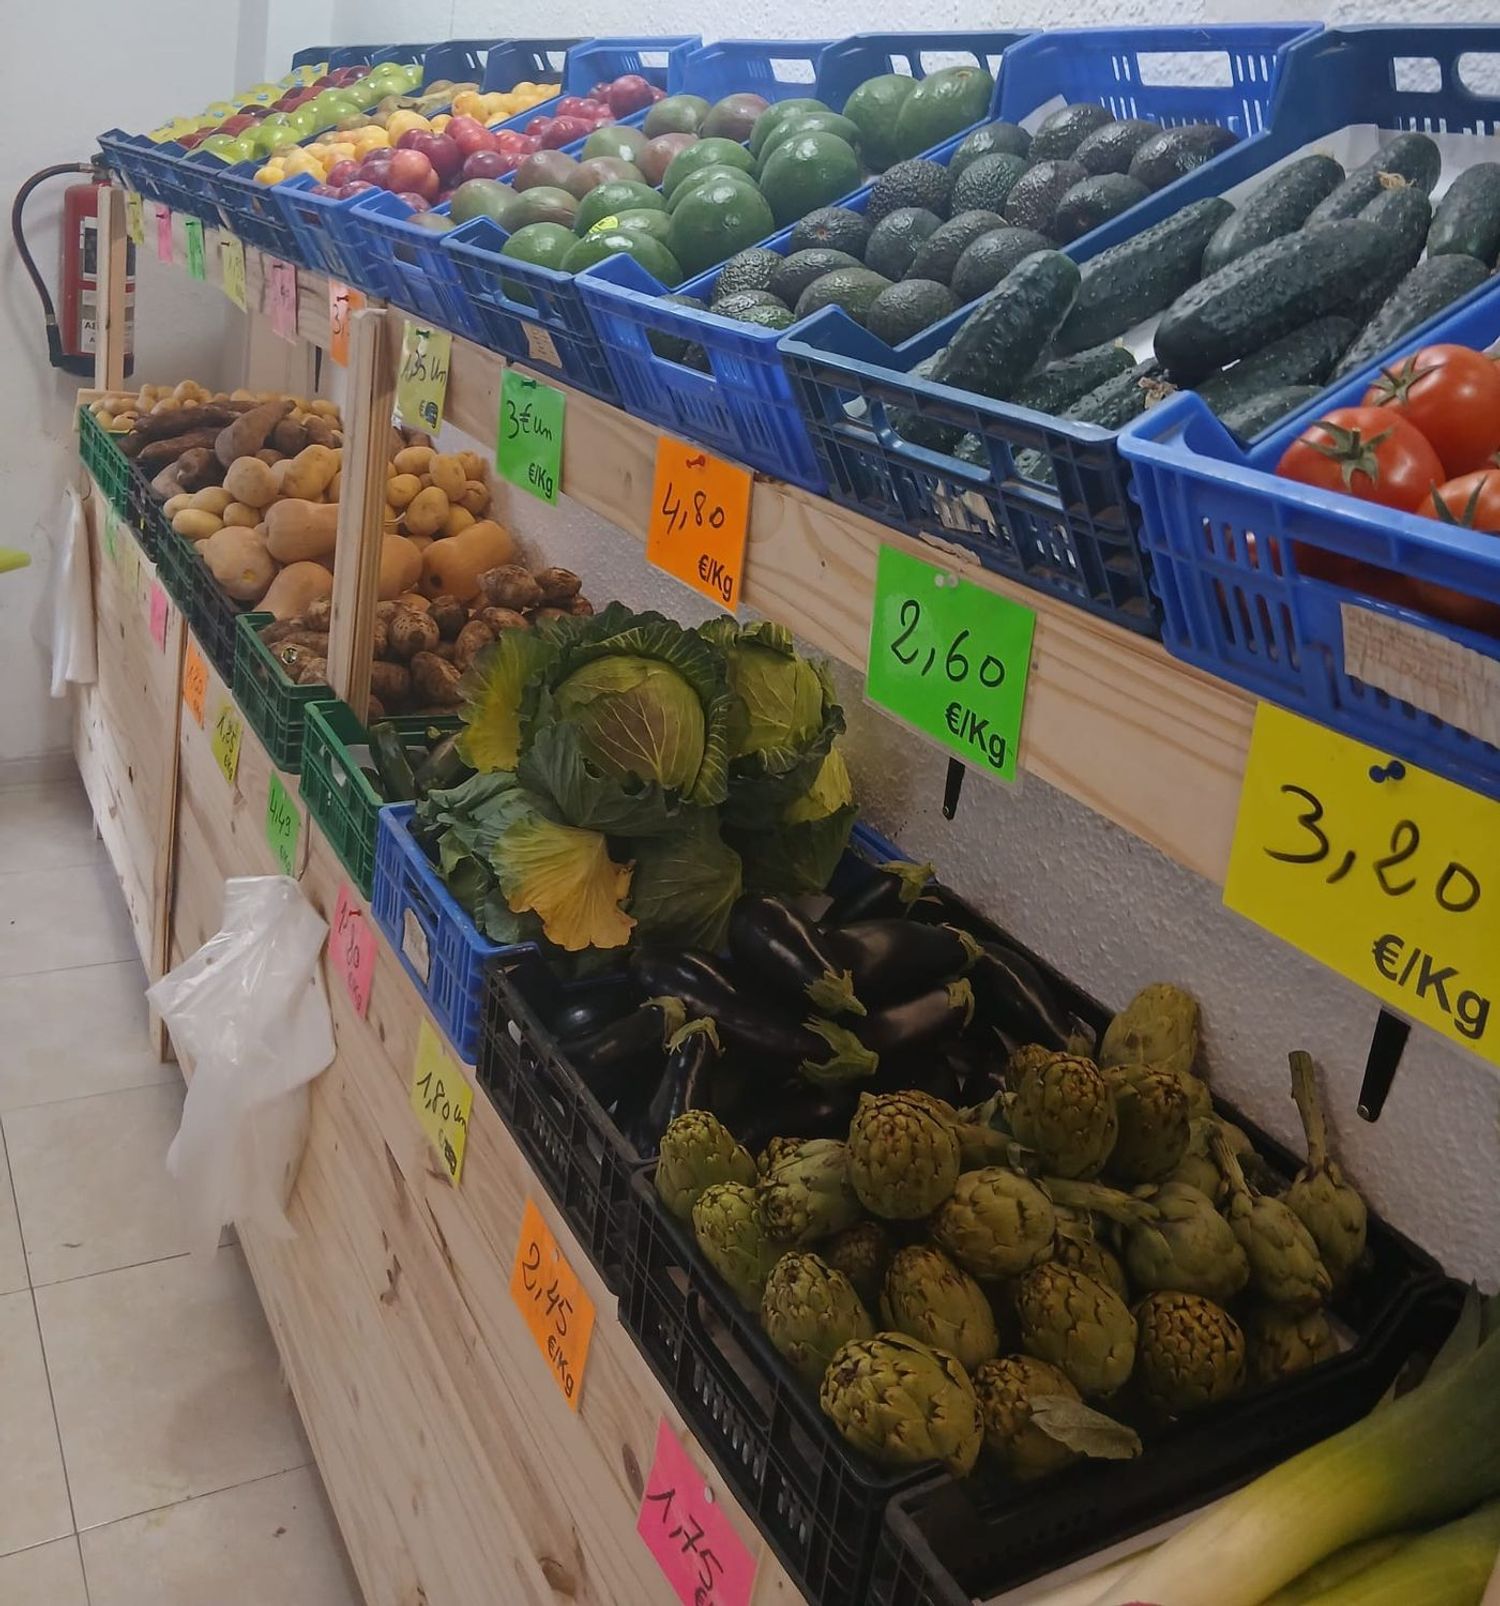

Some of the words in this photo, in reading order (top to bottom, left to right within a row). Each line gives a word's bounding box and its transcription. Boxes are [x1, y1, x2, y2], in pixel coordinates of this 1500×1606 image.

[528, 462, 554, 499] €/Kg
[662, 482, 725, 535] 4,80
[698, 554, 734, 602] €/Kg
[891, 600, 1006, 688] 2,60
[945, 702, 1007, 769] €/Kg
[1263, 784, 1481, 913] 3,20
[1371, 933, 1491, 1040] €/Kg
[417, 1072, 449, 1121] 1,80
[521, 1242, 574, 1337] 2,45
[547, 1335, 575, 1399] €/Kg
[647, 1488, 724, 1592] 1,75
